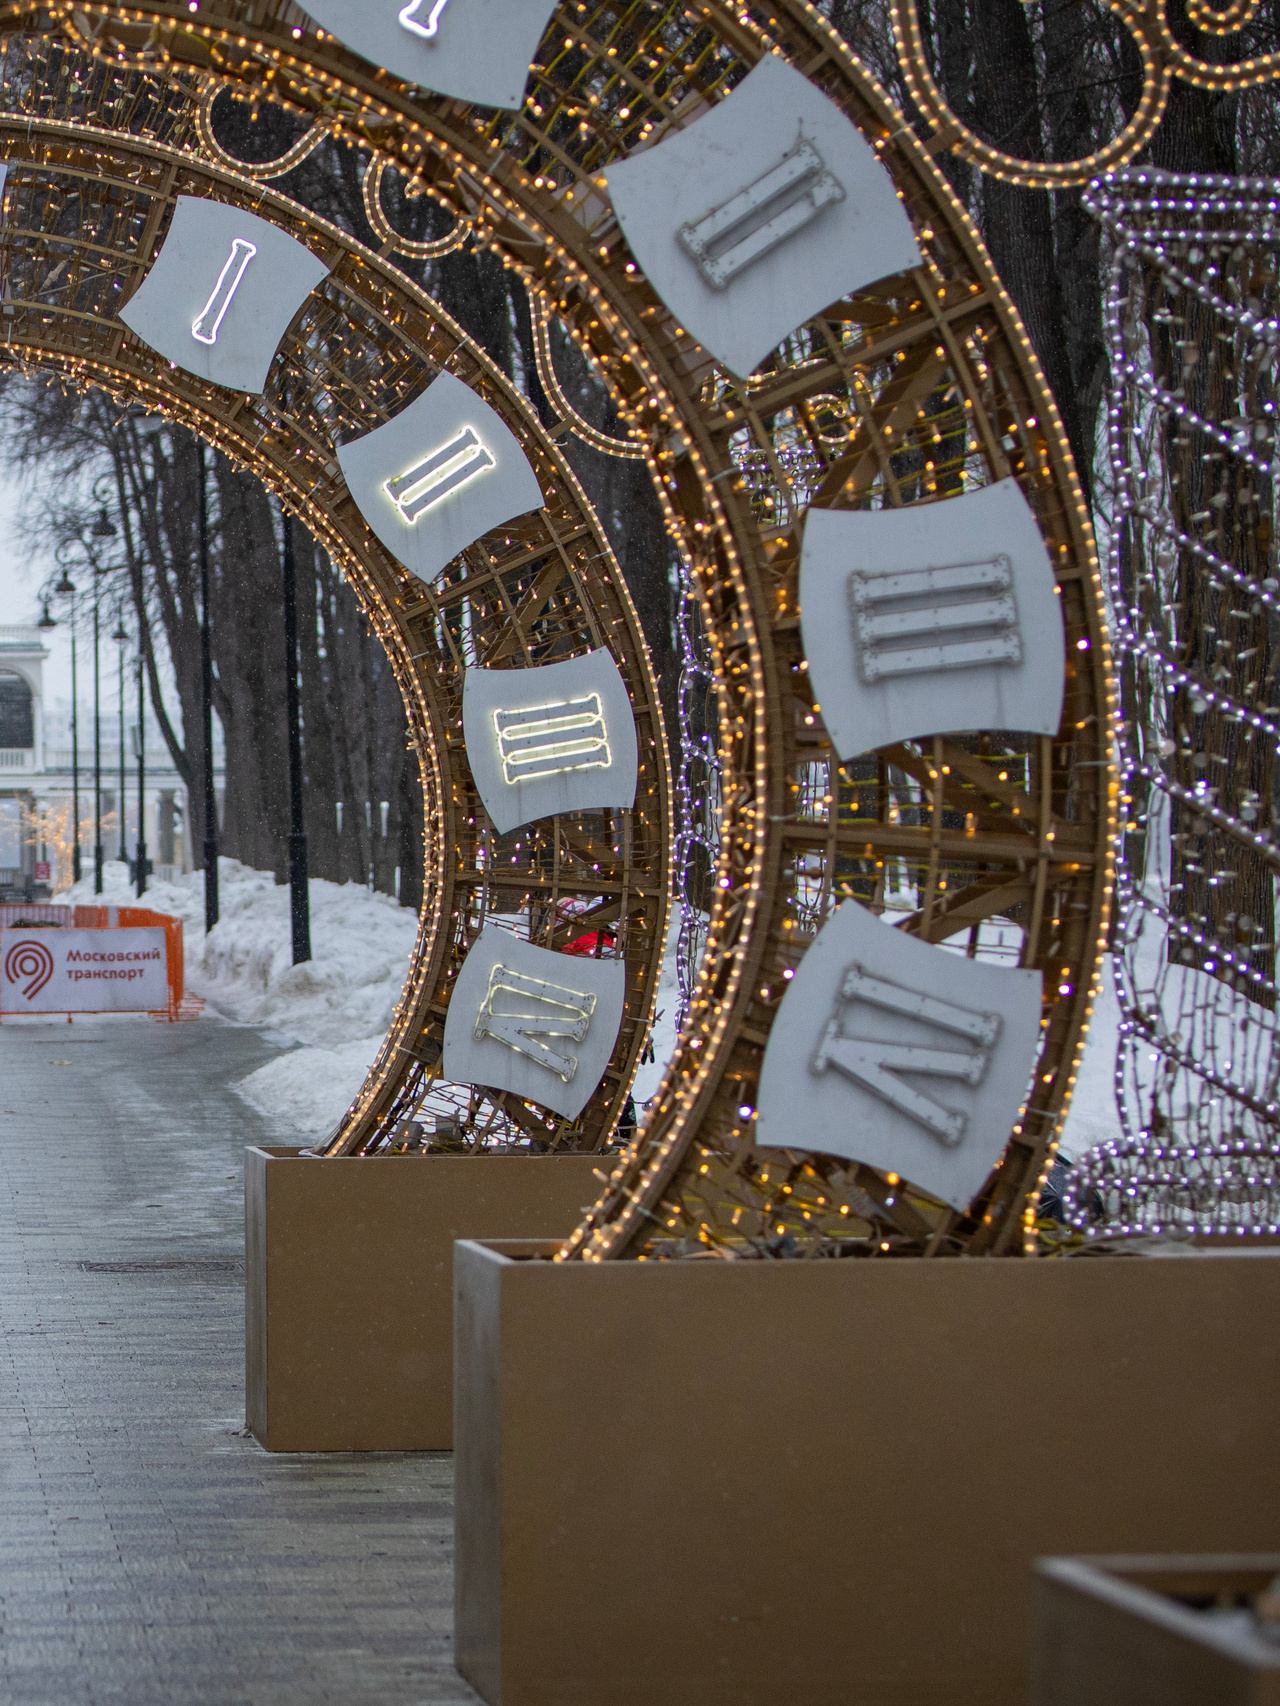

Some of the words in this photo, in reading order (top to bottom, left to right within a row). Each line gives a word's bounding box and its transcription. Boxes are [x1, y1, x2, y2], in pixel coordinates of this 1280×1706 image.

[677, 139, 847, 290] II
[190, 237, 257, 345] I
[383, 424, 497, 525] II
[849, 554, 1023, 683] III
[493, 692, 612, 785] III
[66, 948, 161, 962] Московский
[66, 968, 145, 981] транспорт
[473, 963, 597, 1083] IV
[812, 962, 1002, 1147] IV
